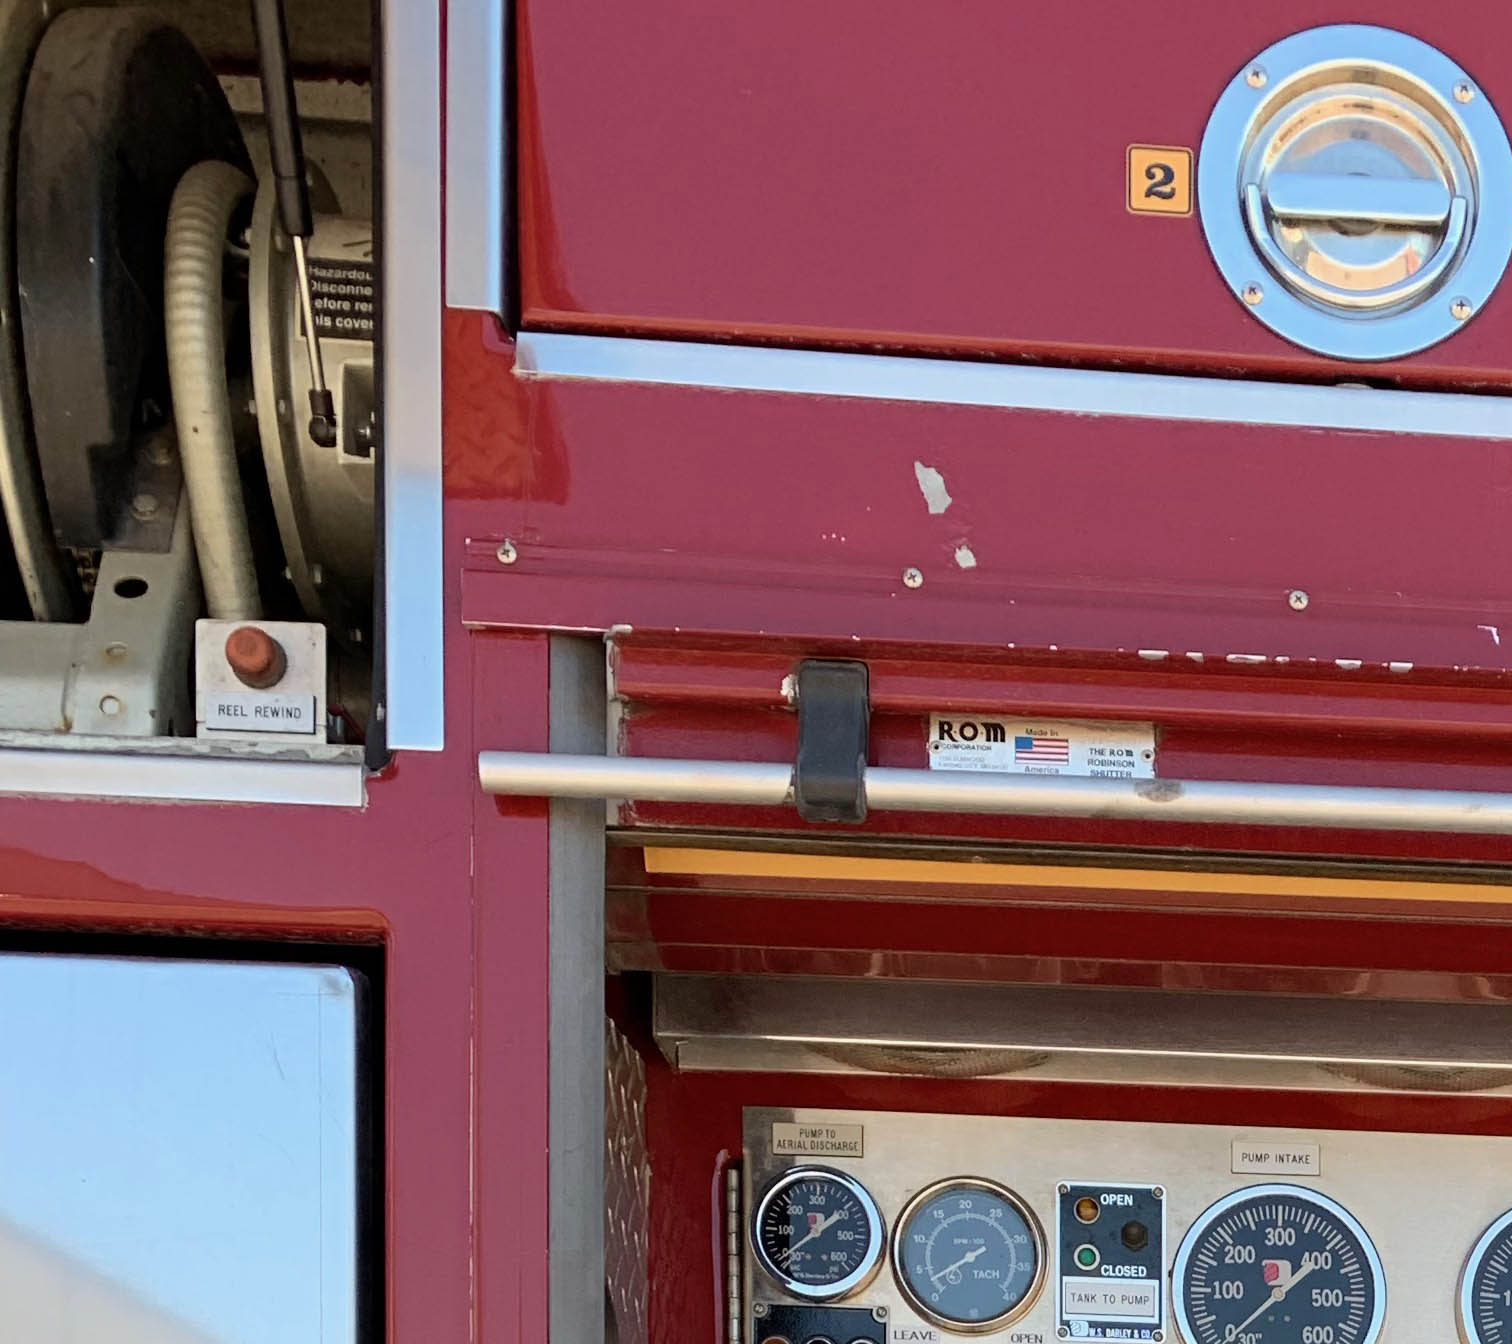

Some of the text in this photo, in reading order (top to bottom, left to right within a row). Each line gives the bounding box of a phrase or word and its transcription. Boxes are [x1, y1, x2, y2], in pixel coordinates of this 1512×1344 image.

[1144, 163, 1176, 200] 2
[218, 704, 302, 719] REEL REWIND
[1025, 727, 1043, 737] Made
[1024, 765, 1060, 775] America
[1088, 758, 1135, 769] ROBINSON
[1090, 769, 1133, 778] SHUTTER
[800, 1128, 836, 1139] PUMP TO
[776, 1139, 859, 1152] AERIAL DISCHARGE
[1241, 1152, 1311, 1165] PUMP INTAKE
[1100, 1193, 1134, 1207] OPEN
[1264, 1227, 1296, 1247] 300
[1224, 1245, 1256, 1265] 200
[1301, 1251, 1333, 1270] 400
[973, 1269, 1000, 1280] TACH
[1101, 1264, 1147, 1278] CLOSED
[1213, 1280, 1244, 1300] 100
[1070, 1292, 1151, 1306] TANK TO PUMP
[1311, 1288, 1343, 1308] 500
[893, 1329, 1043, 1344] LEAVE OPEN
[1302, 1325, 1334, 1344] 600
